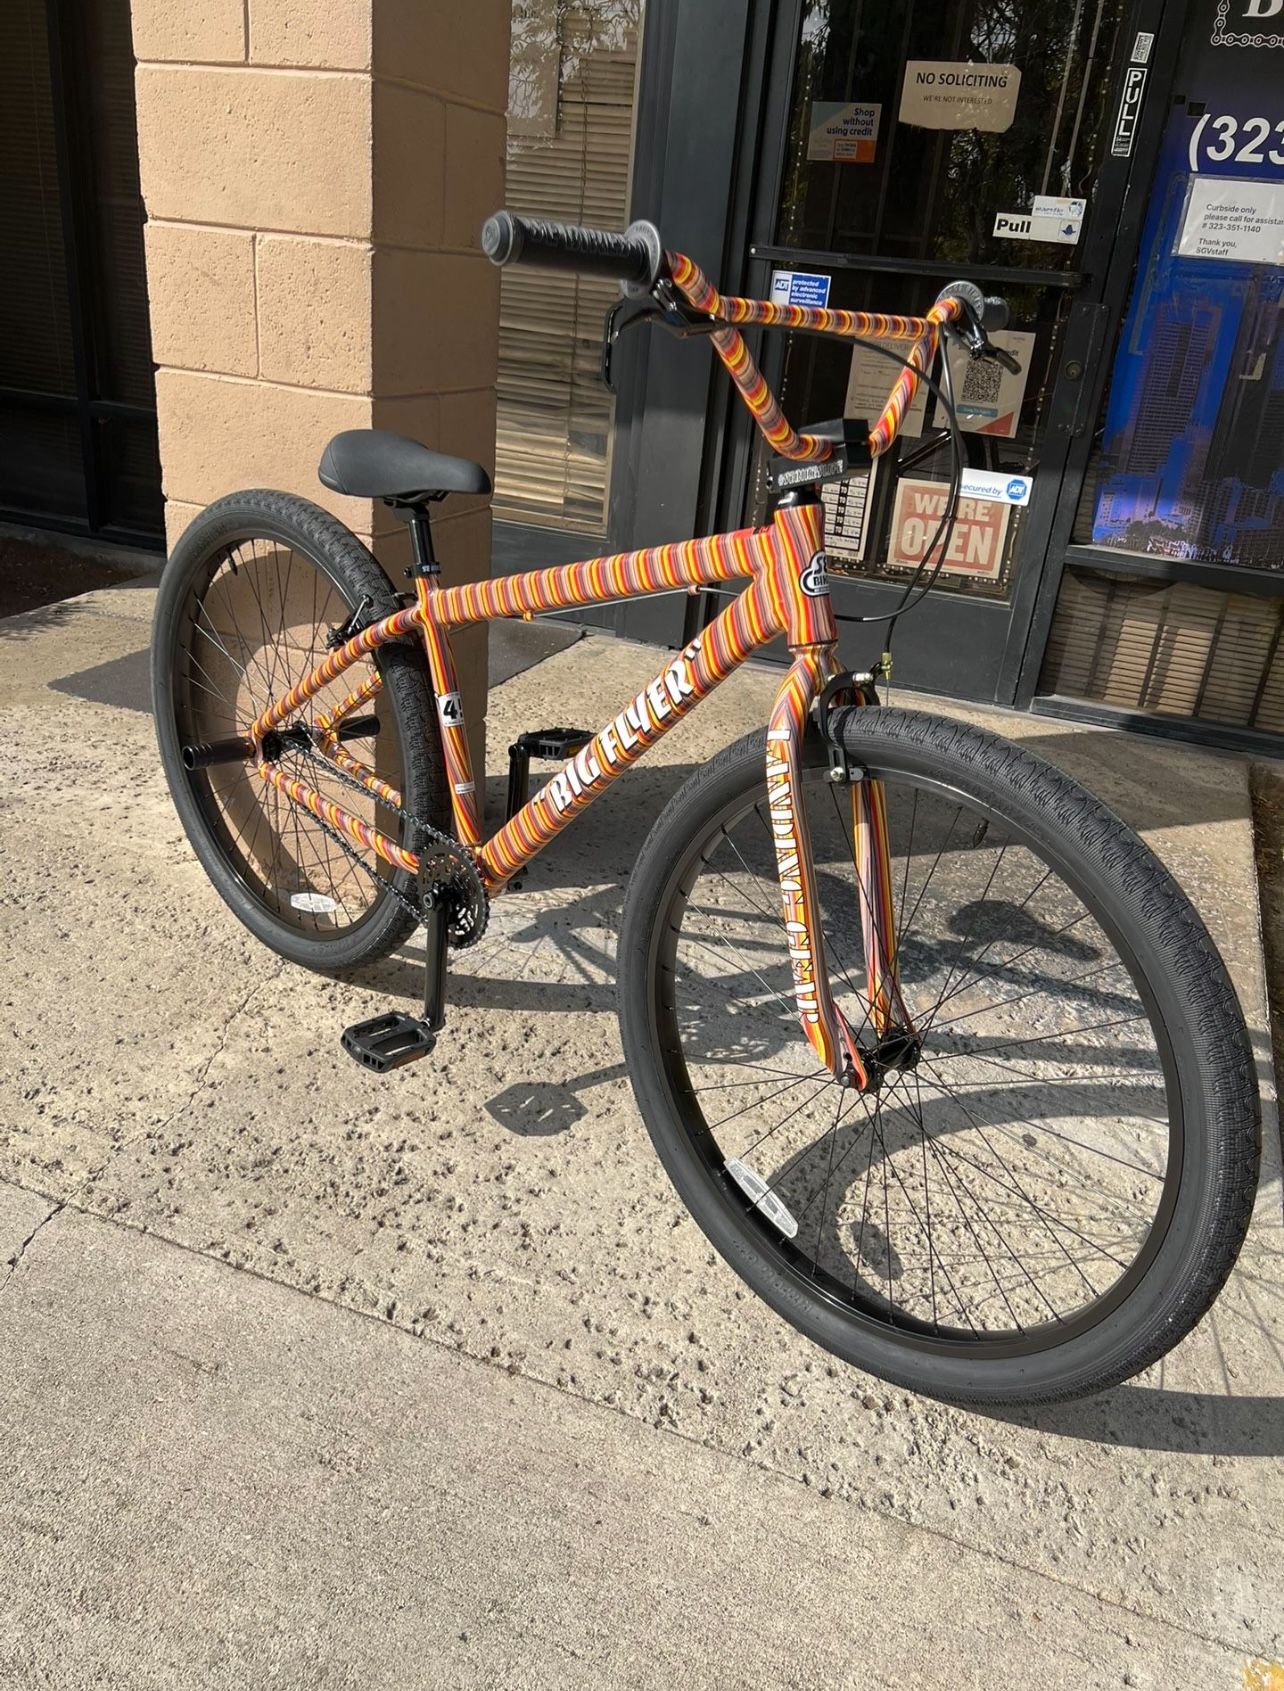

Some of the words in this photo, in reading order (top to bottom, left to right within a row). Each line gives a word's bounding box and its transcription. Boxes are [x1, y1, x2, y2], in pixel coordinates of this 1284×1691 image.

[916, 72, 935, 85] NO
[938, 73, 1008, 88] SOLICITING
[943, 95, 955, 103] NOT
[956, 96, 993, 105] INTERESTED
[1118, 71, 1142, 136] PULL
[854, 108, 875, 118] Shop
[842, 117, 874, 127] without
[826, 127, 849, 136] using
[849, 127, 873, 136] credit
[1206, 203, 1240, 213] Curbside
[1240, 206, 1257, 215] only
[1204, 213, 1228, 222] please
[996, 219, 1032, 233] Pull
[1208, 222, 1261, 233] 323-351-1140
[1199, 238, 1221, 246] Thank
[1221, 240, 1238, 249] you,
[1196, 246, 1229, 256] SGVstaff
[775, 279, 789, 291] ADT
[791, 285, 799, 293] by
[799, 286, 827, 294] advanced
[992, 487, 1004, 496] by
[914, 493, 992, 522] WERE
[901, 517, 994, 565] OPEN
